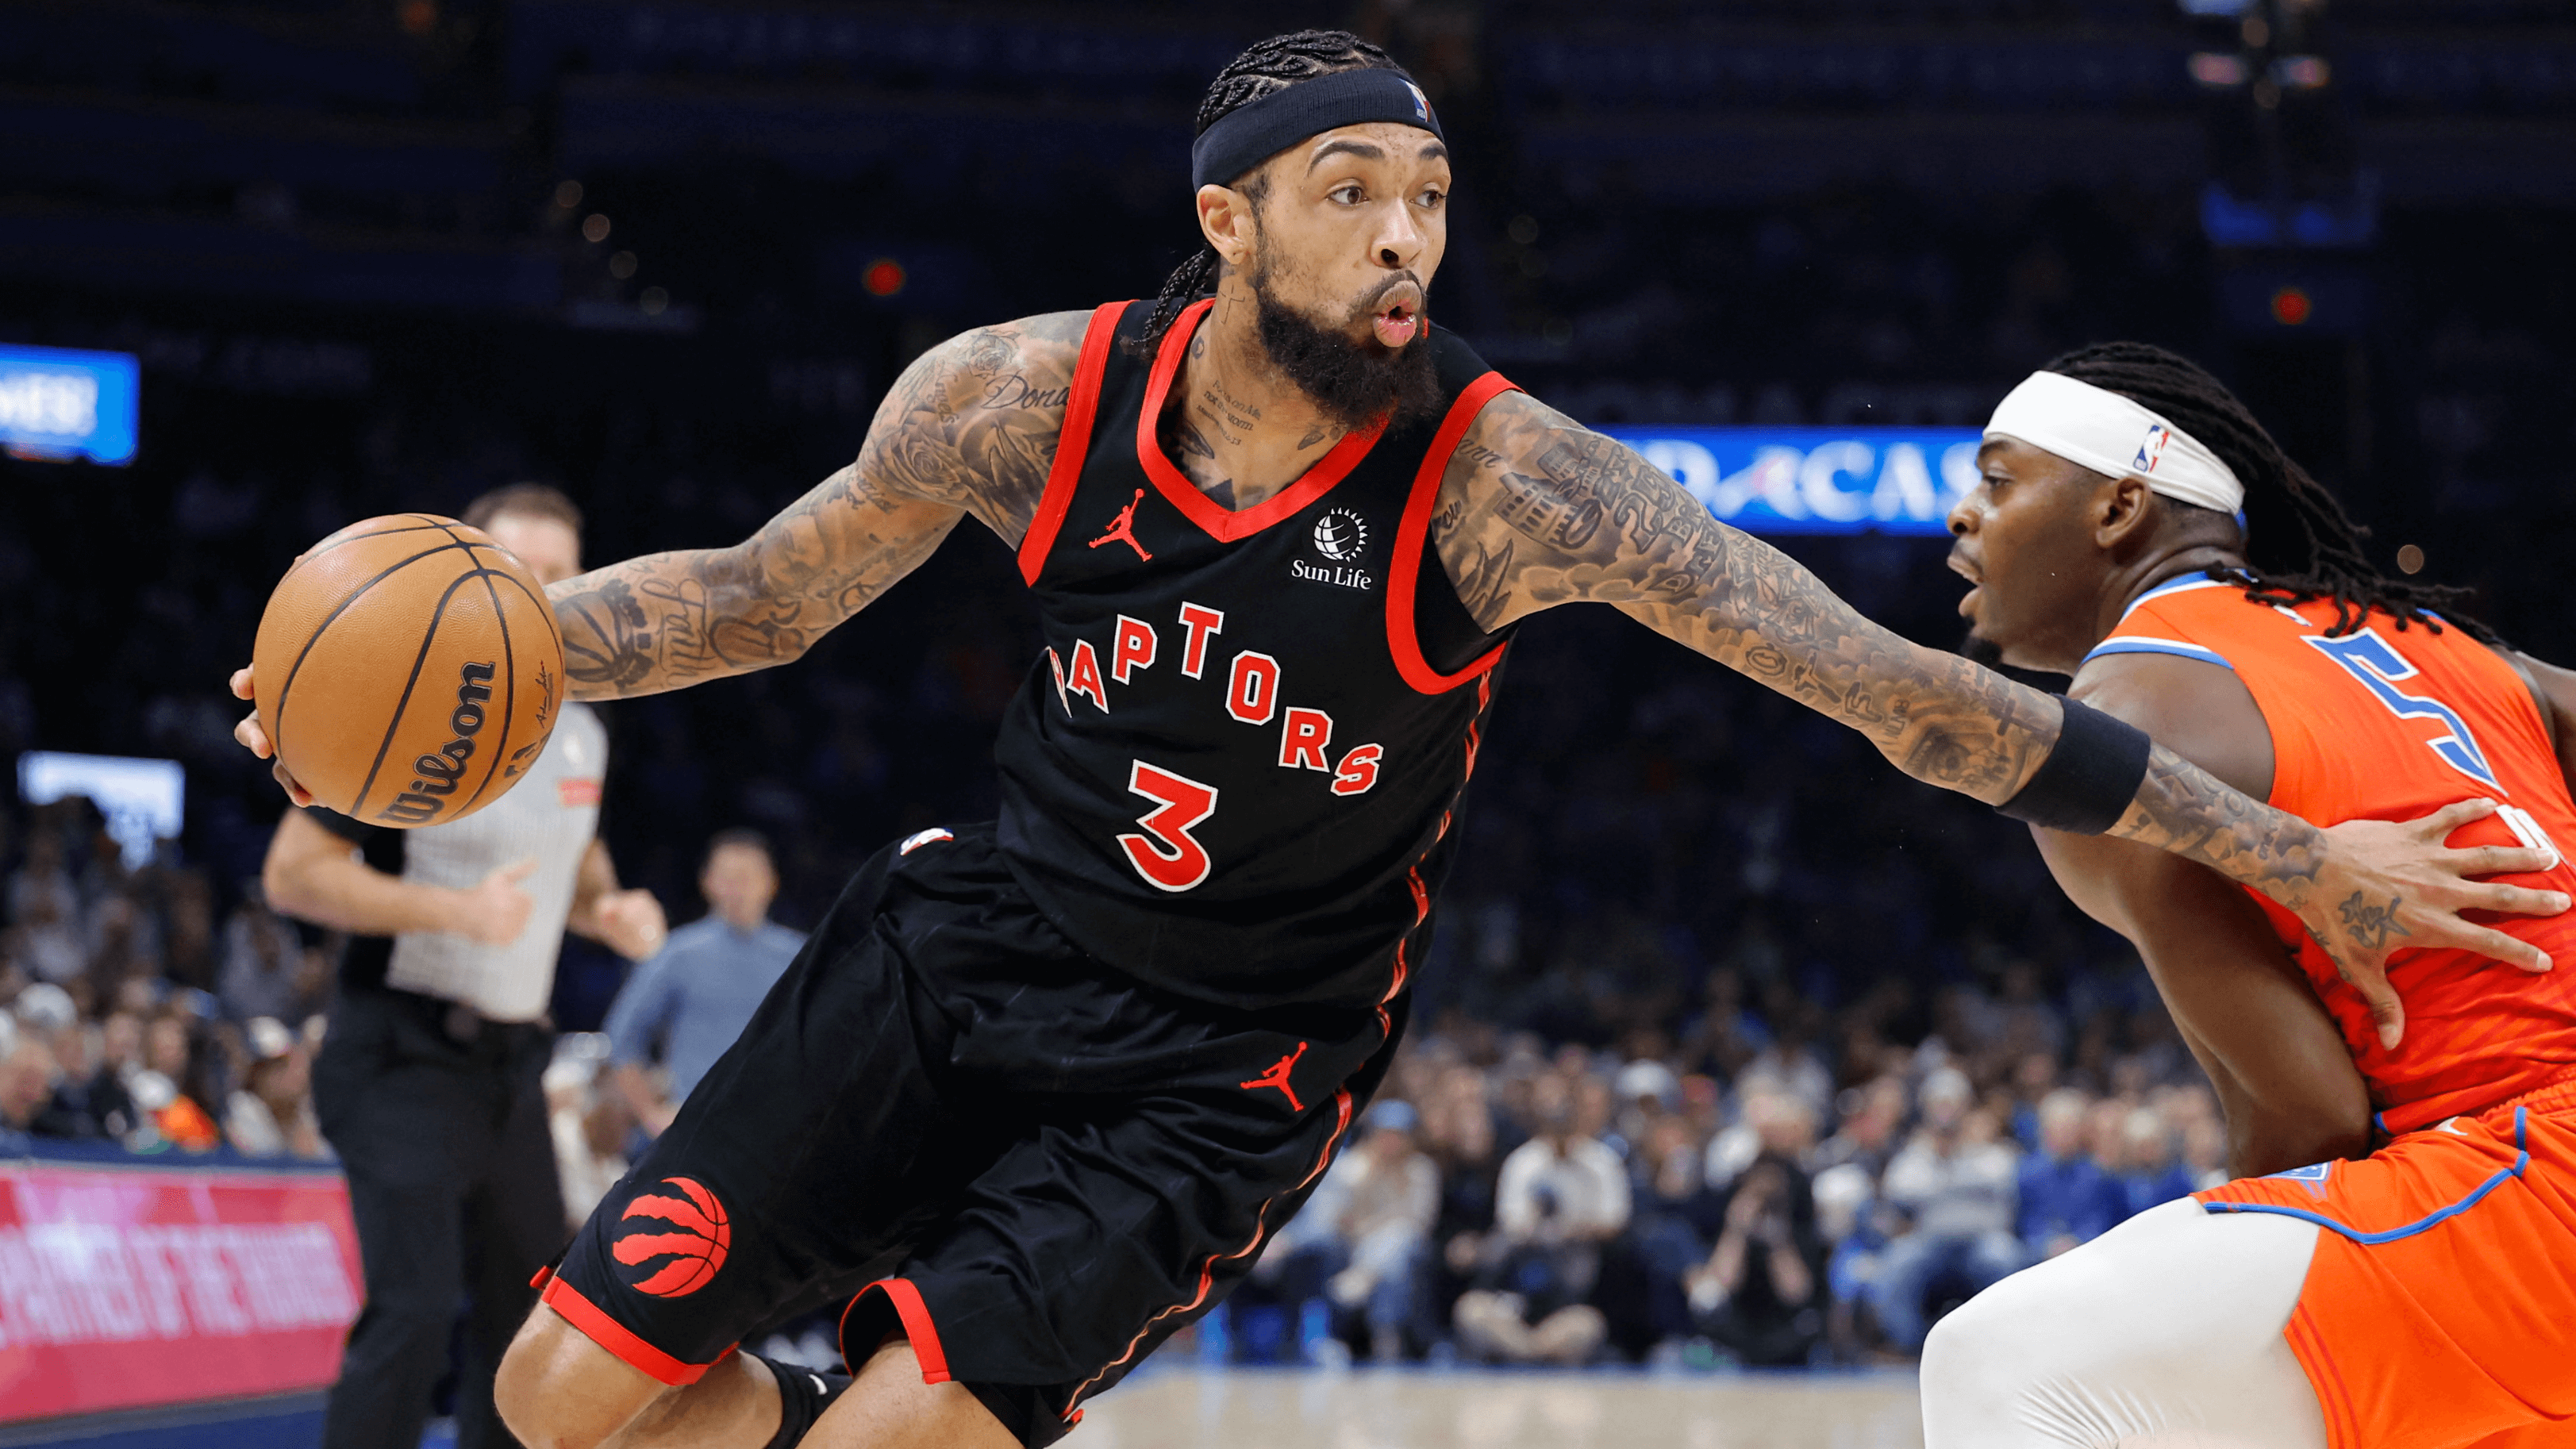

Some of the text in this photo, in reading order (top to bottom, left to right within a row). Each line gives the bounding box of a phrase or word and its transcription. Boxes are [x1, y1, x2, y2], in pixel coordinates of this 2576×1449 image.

[1291, 559, 1371, 590] Sun Life
[375, 662, 496, 824] Wilson
[2299, 626, 2510, 797] 5
[1115, 759, 1218, 892] 3
